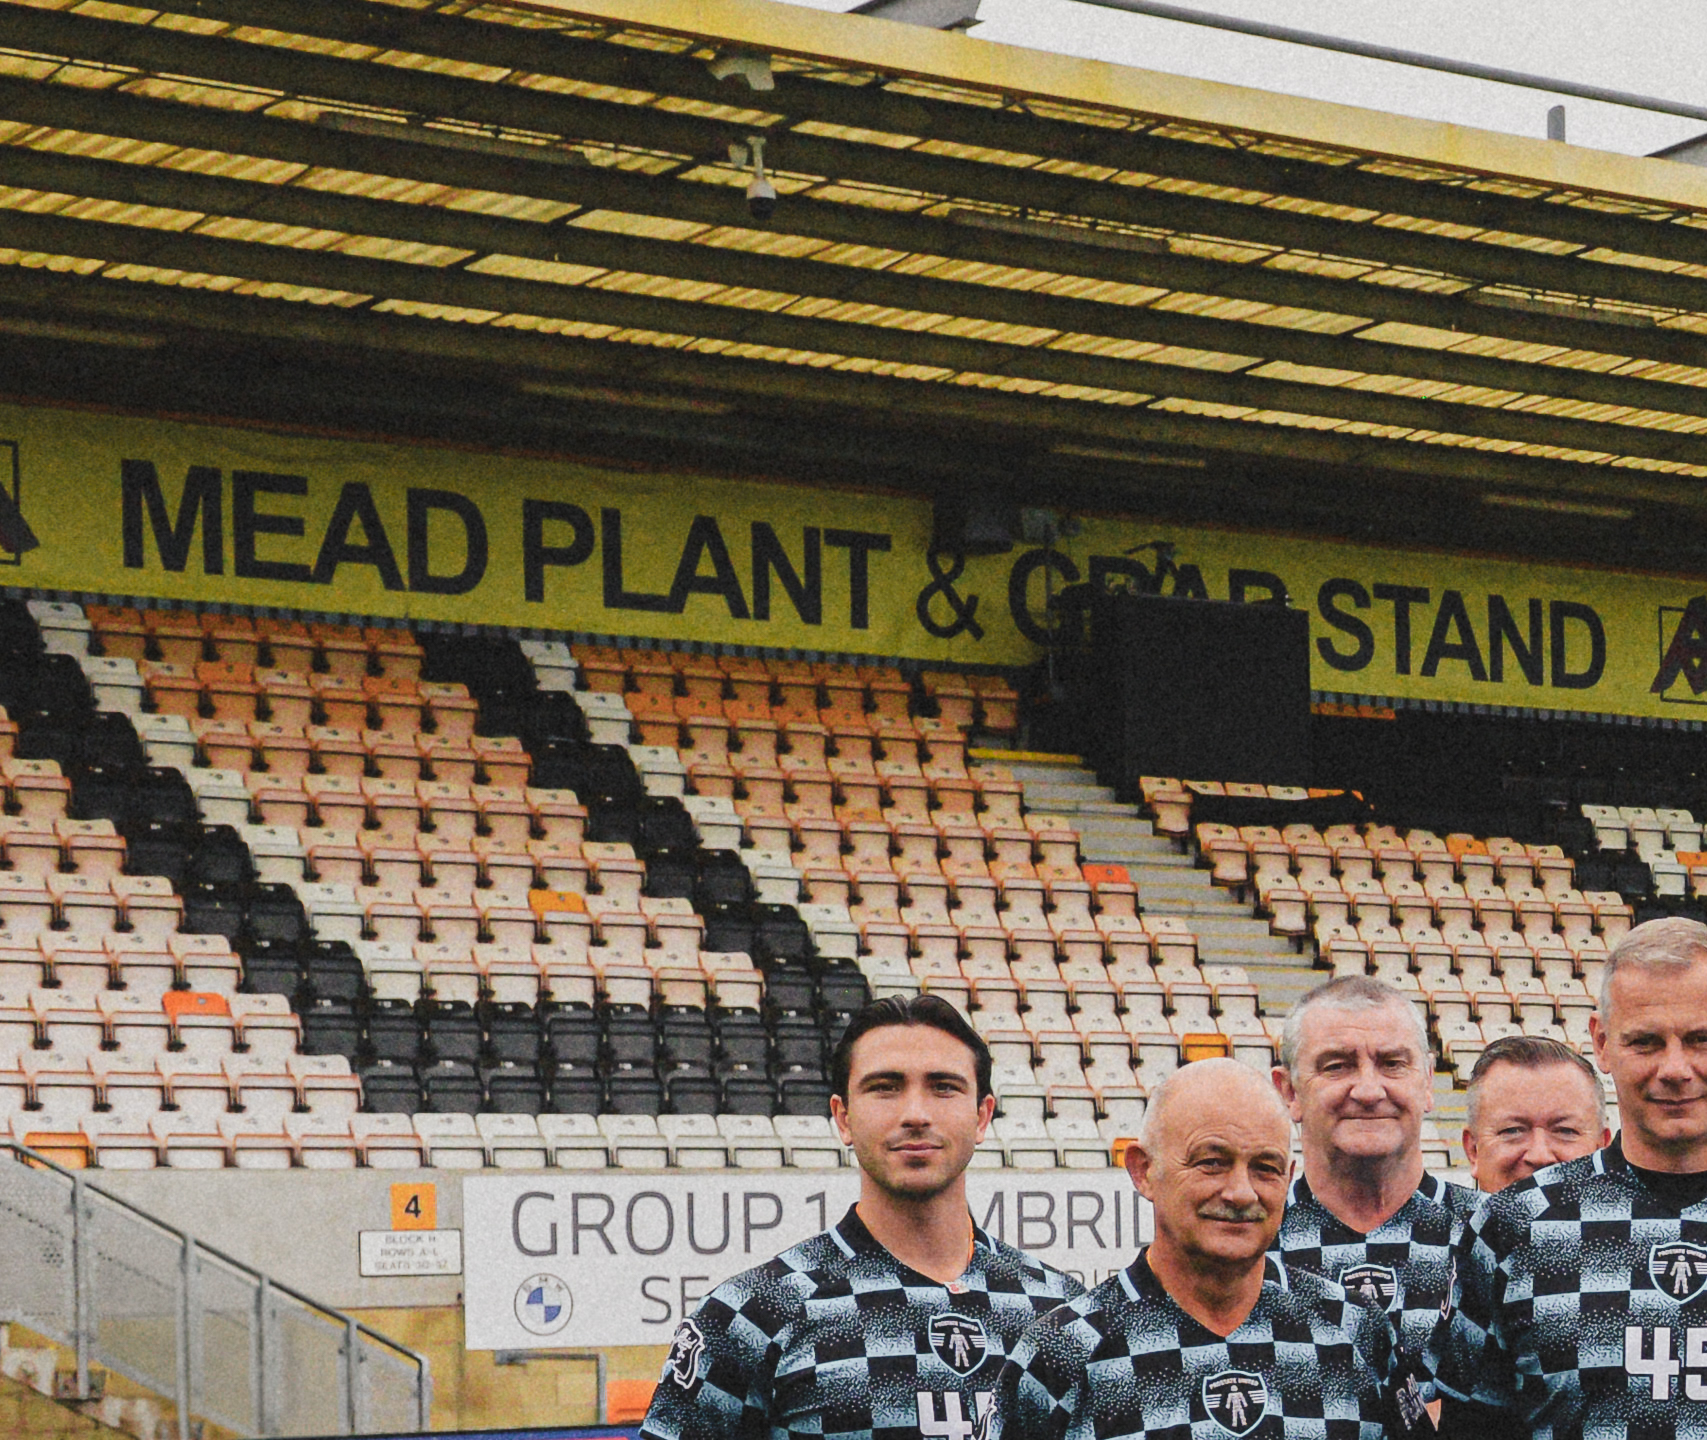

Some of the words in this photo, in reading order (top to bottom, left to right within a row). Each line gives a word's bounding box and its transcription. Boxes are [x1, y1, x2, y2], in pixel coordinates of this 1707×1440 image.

[121, 458, 488, 595] MEAD
[521, 498, 893, 630] PLANT
[915, 540, 985, 642] &
[1315, 576, 1607, 691] STAND
[404, 1194, 422, 1219] 4
[511, 1190, 783, 1258] GROUP
[804, 1190, 827, 1234] 1
